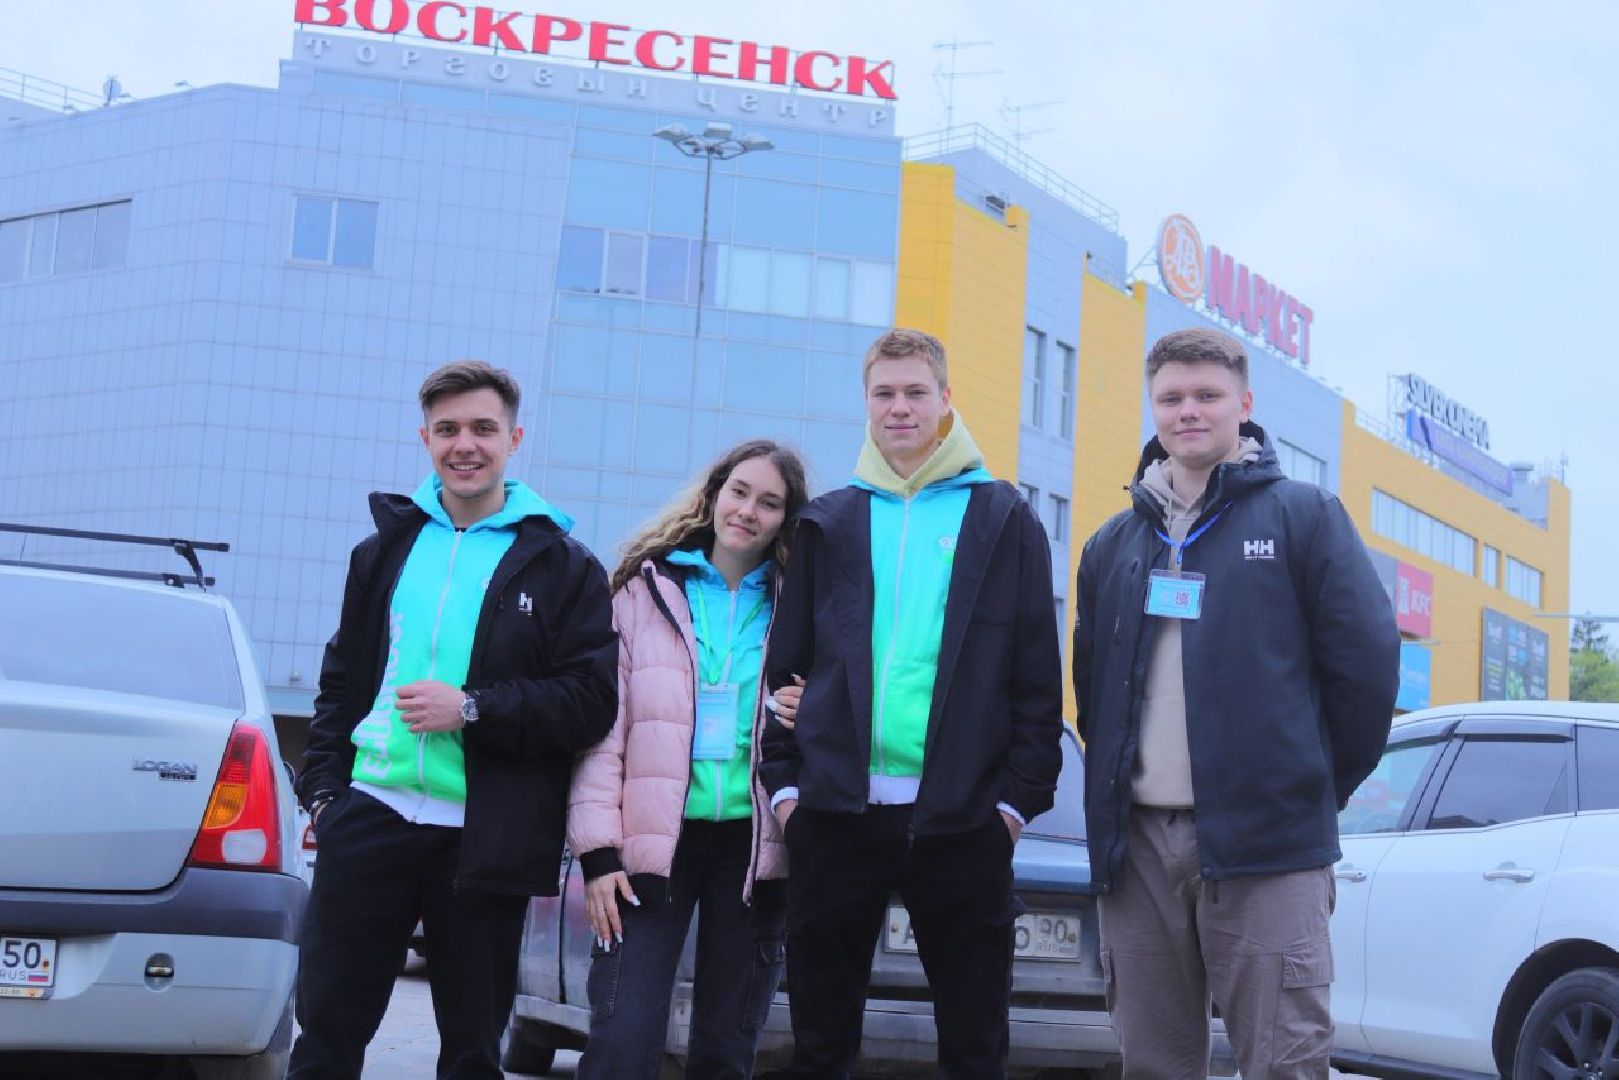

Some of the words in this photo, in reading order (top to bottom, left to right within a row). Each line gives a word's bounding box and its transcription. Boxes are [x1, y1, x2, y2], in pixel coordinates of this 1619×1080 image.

[294, 0, 898, 100] ВОСКРЕСЕНСК
[696, 86, 889, 128] центр
[1206, 245, 1313, 368] МАРКЕТ
[1243, 539, 1275, 556] HH
[2, 940, 42, 969] 50
